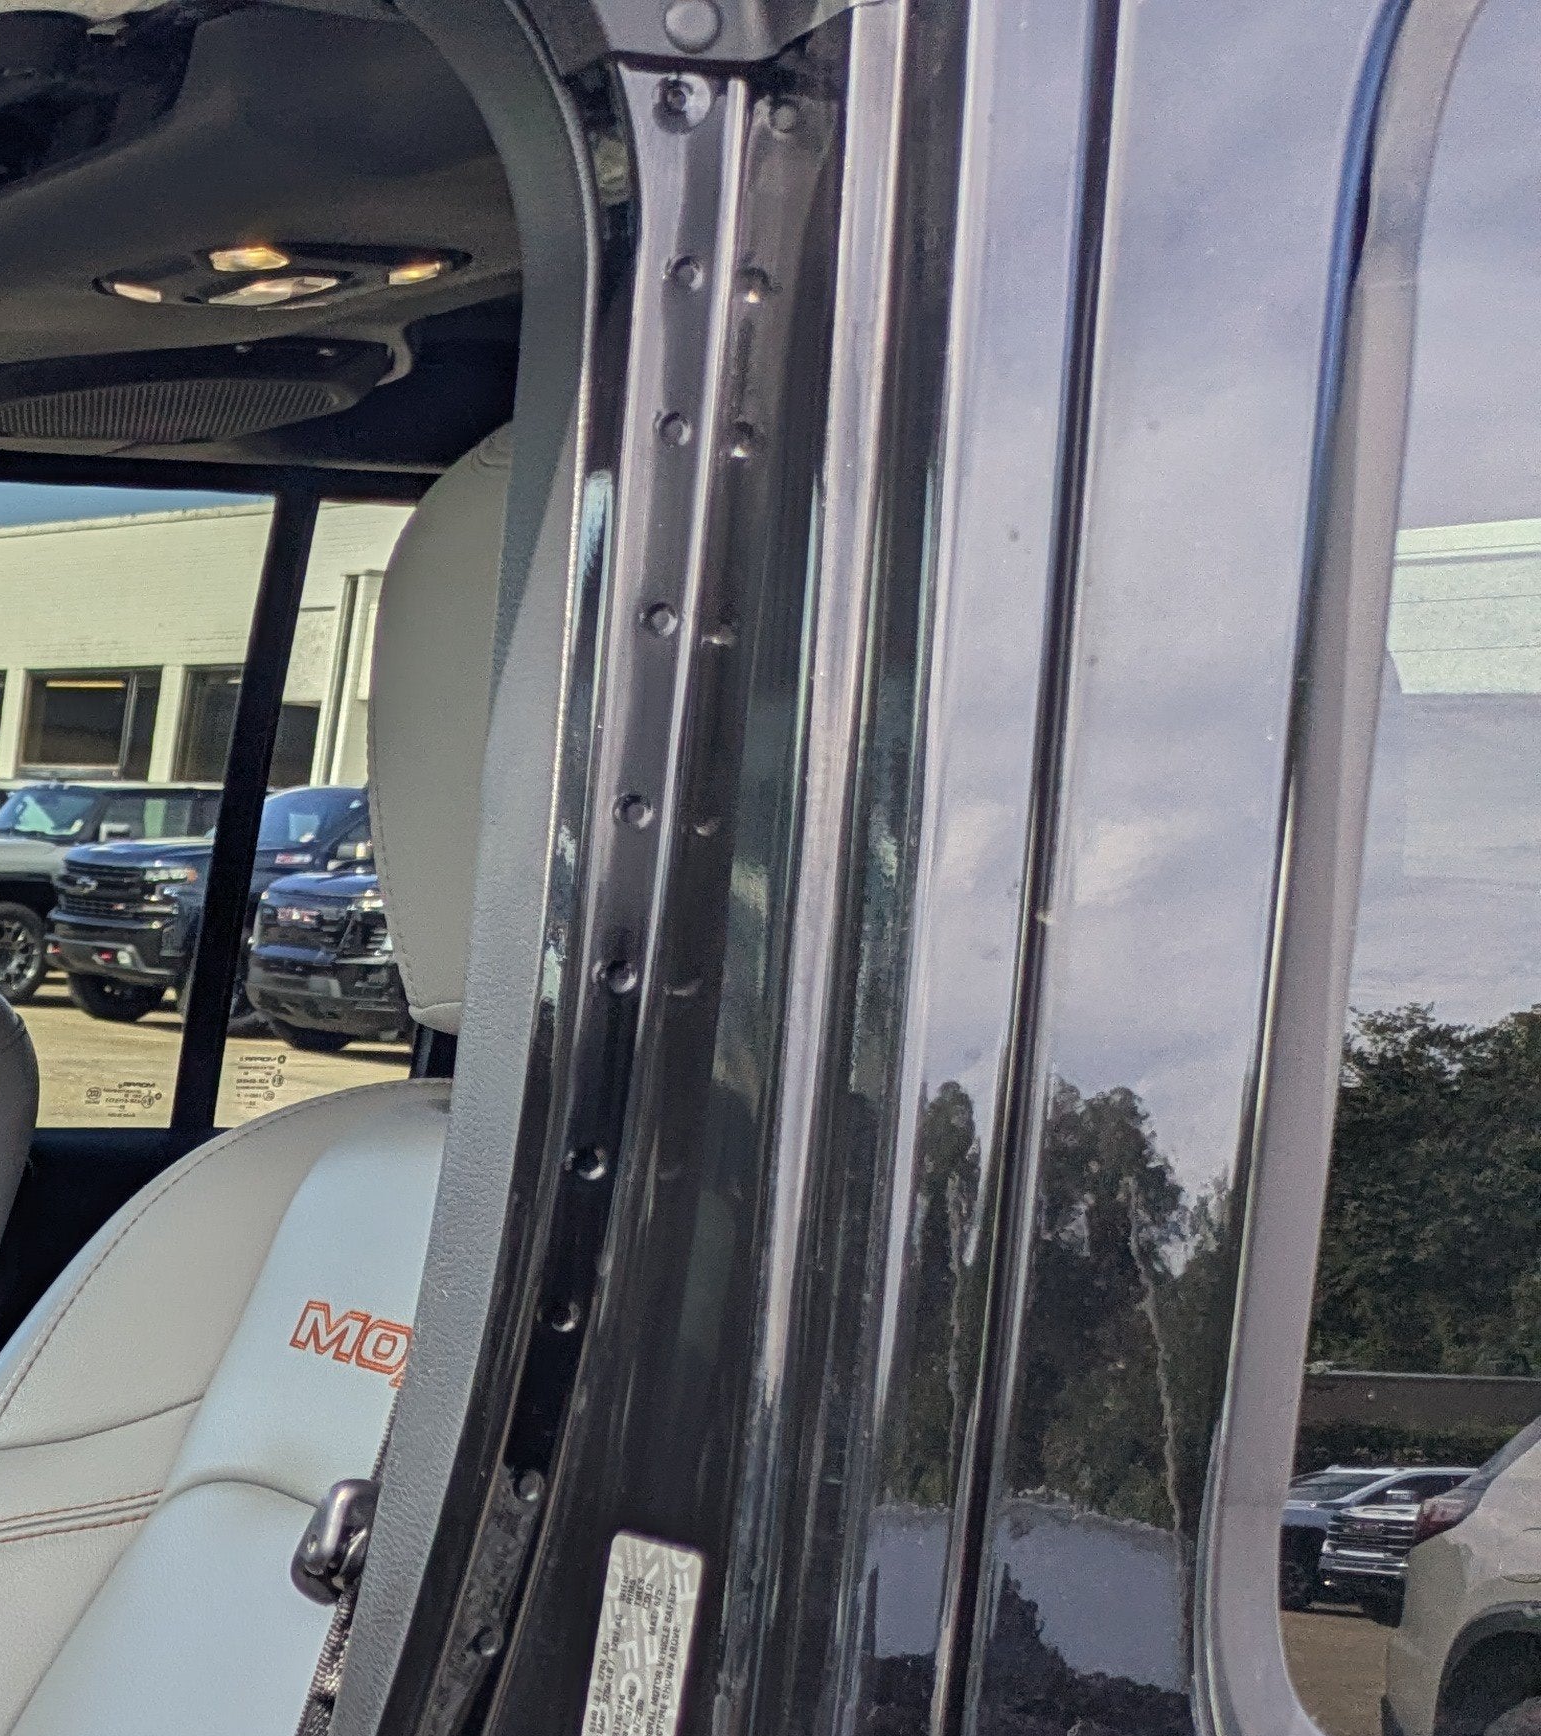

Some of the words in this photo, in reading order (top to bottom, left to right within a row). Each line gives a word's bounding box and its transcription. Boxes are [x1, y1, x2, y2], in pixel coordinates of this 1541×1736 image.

[649, 1669, 663, 1706] MOTOR
[656, 1624, 671, 1667] VEHICLE
[664, 1583, 678, 1623] SAFETY
[661, 1661, 675, 1700] SHOWN
